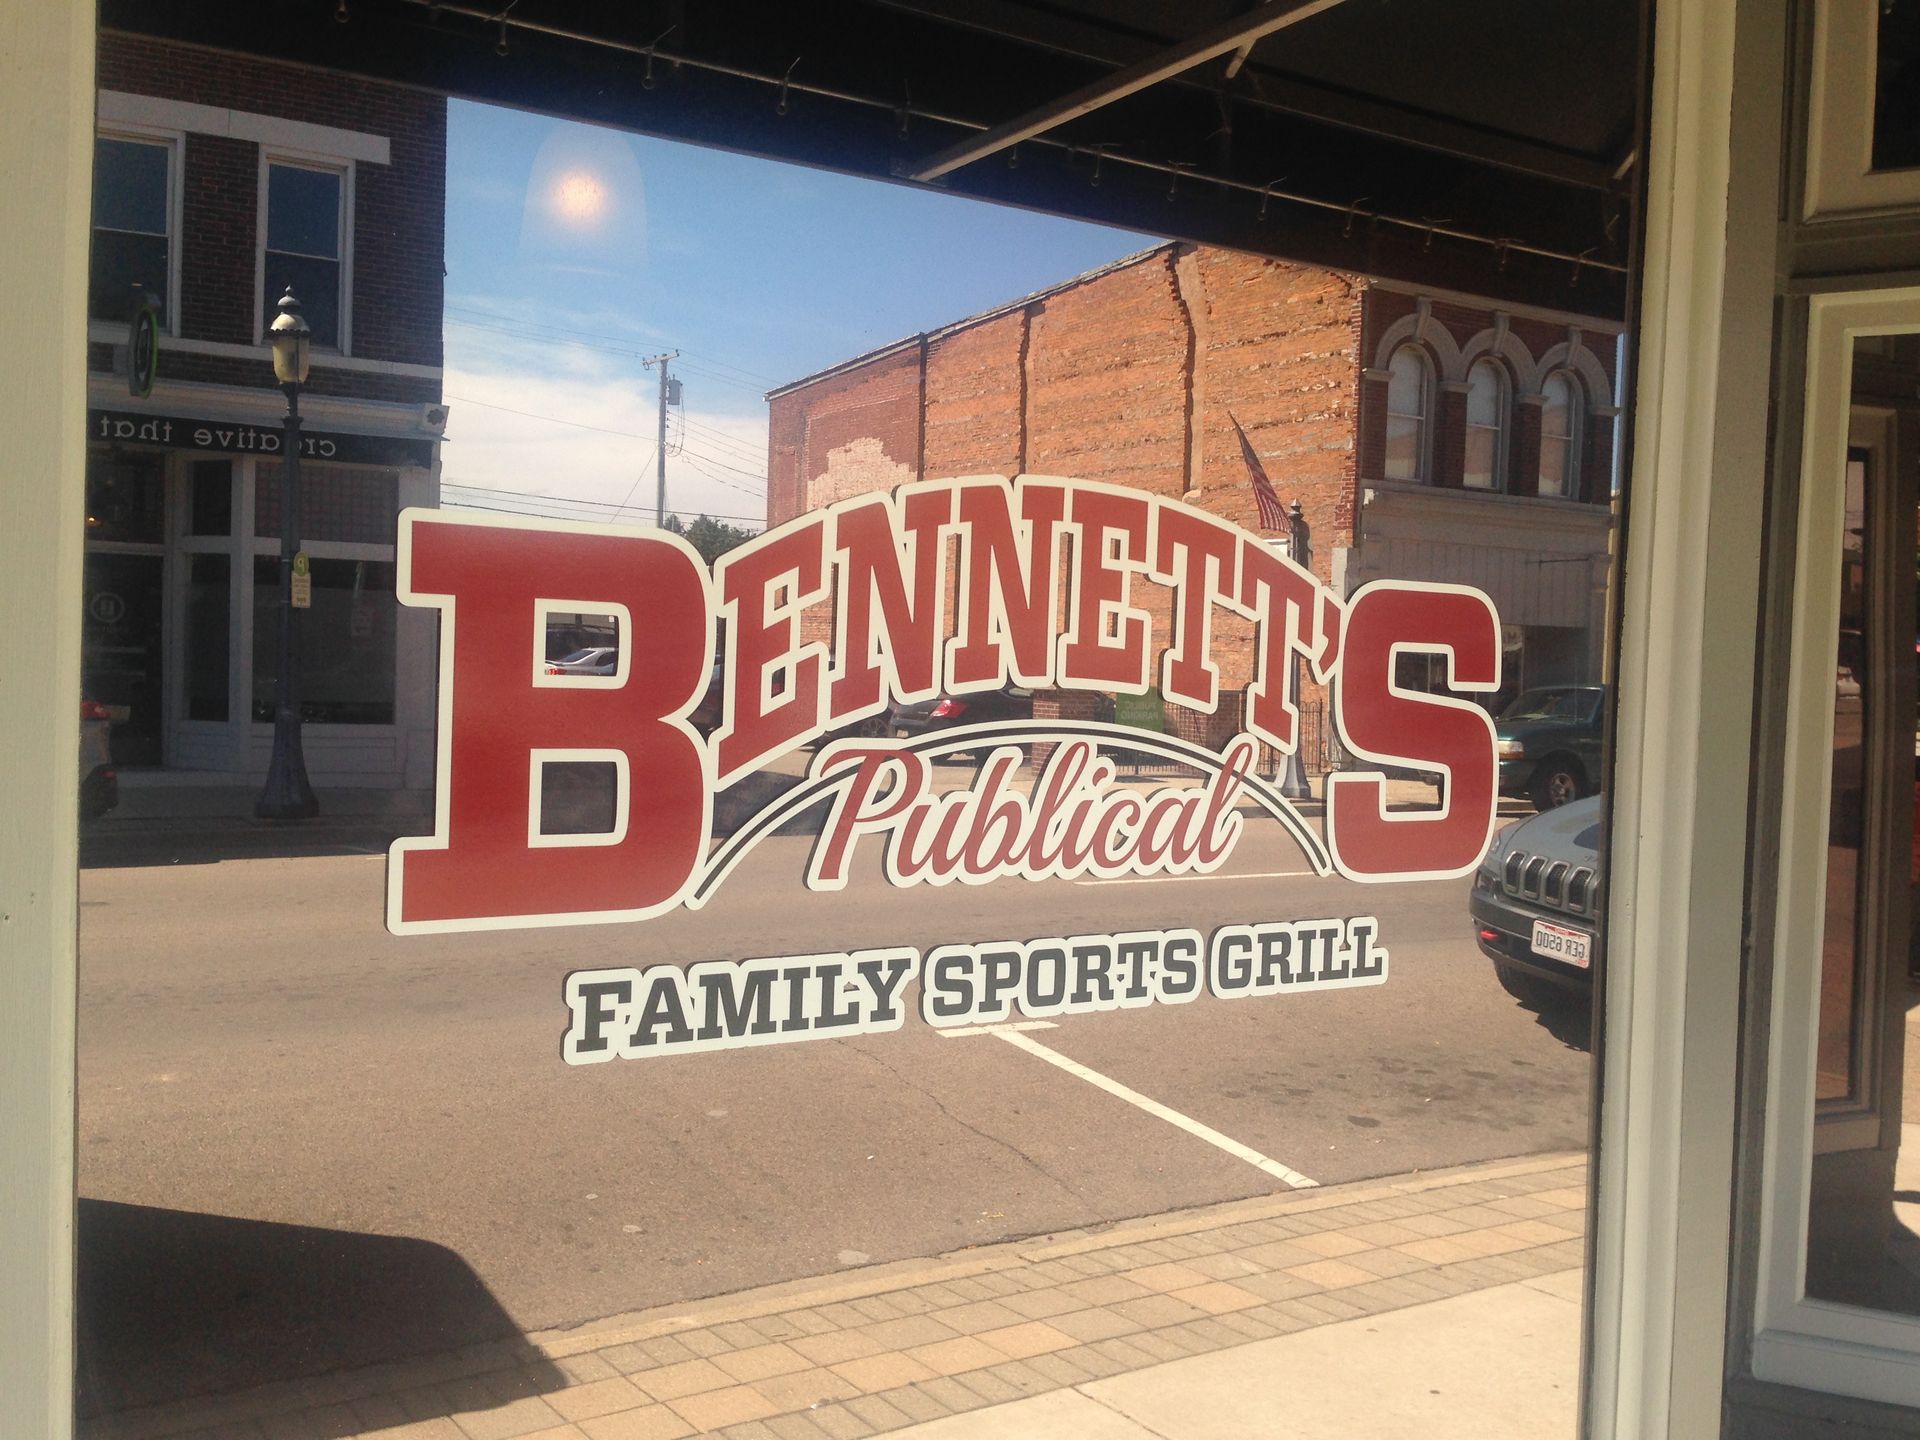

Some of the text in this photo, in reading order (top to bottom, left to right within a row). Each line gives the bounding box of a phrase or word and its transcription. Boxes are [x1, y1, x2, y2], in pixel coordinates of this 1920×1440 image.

[398, 482, 1498, 926] BENNETT'S
[819, 740, 1255, 882] Publical
[575, 925, 1383, 1053] FAMILY SPORTS GRILL
